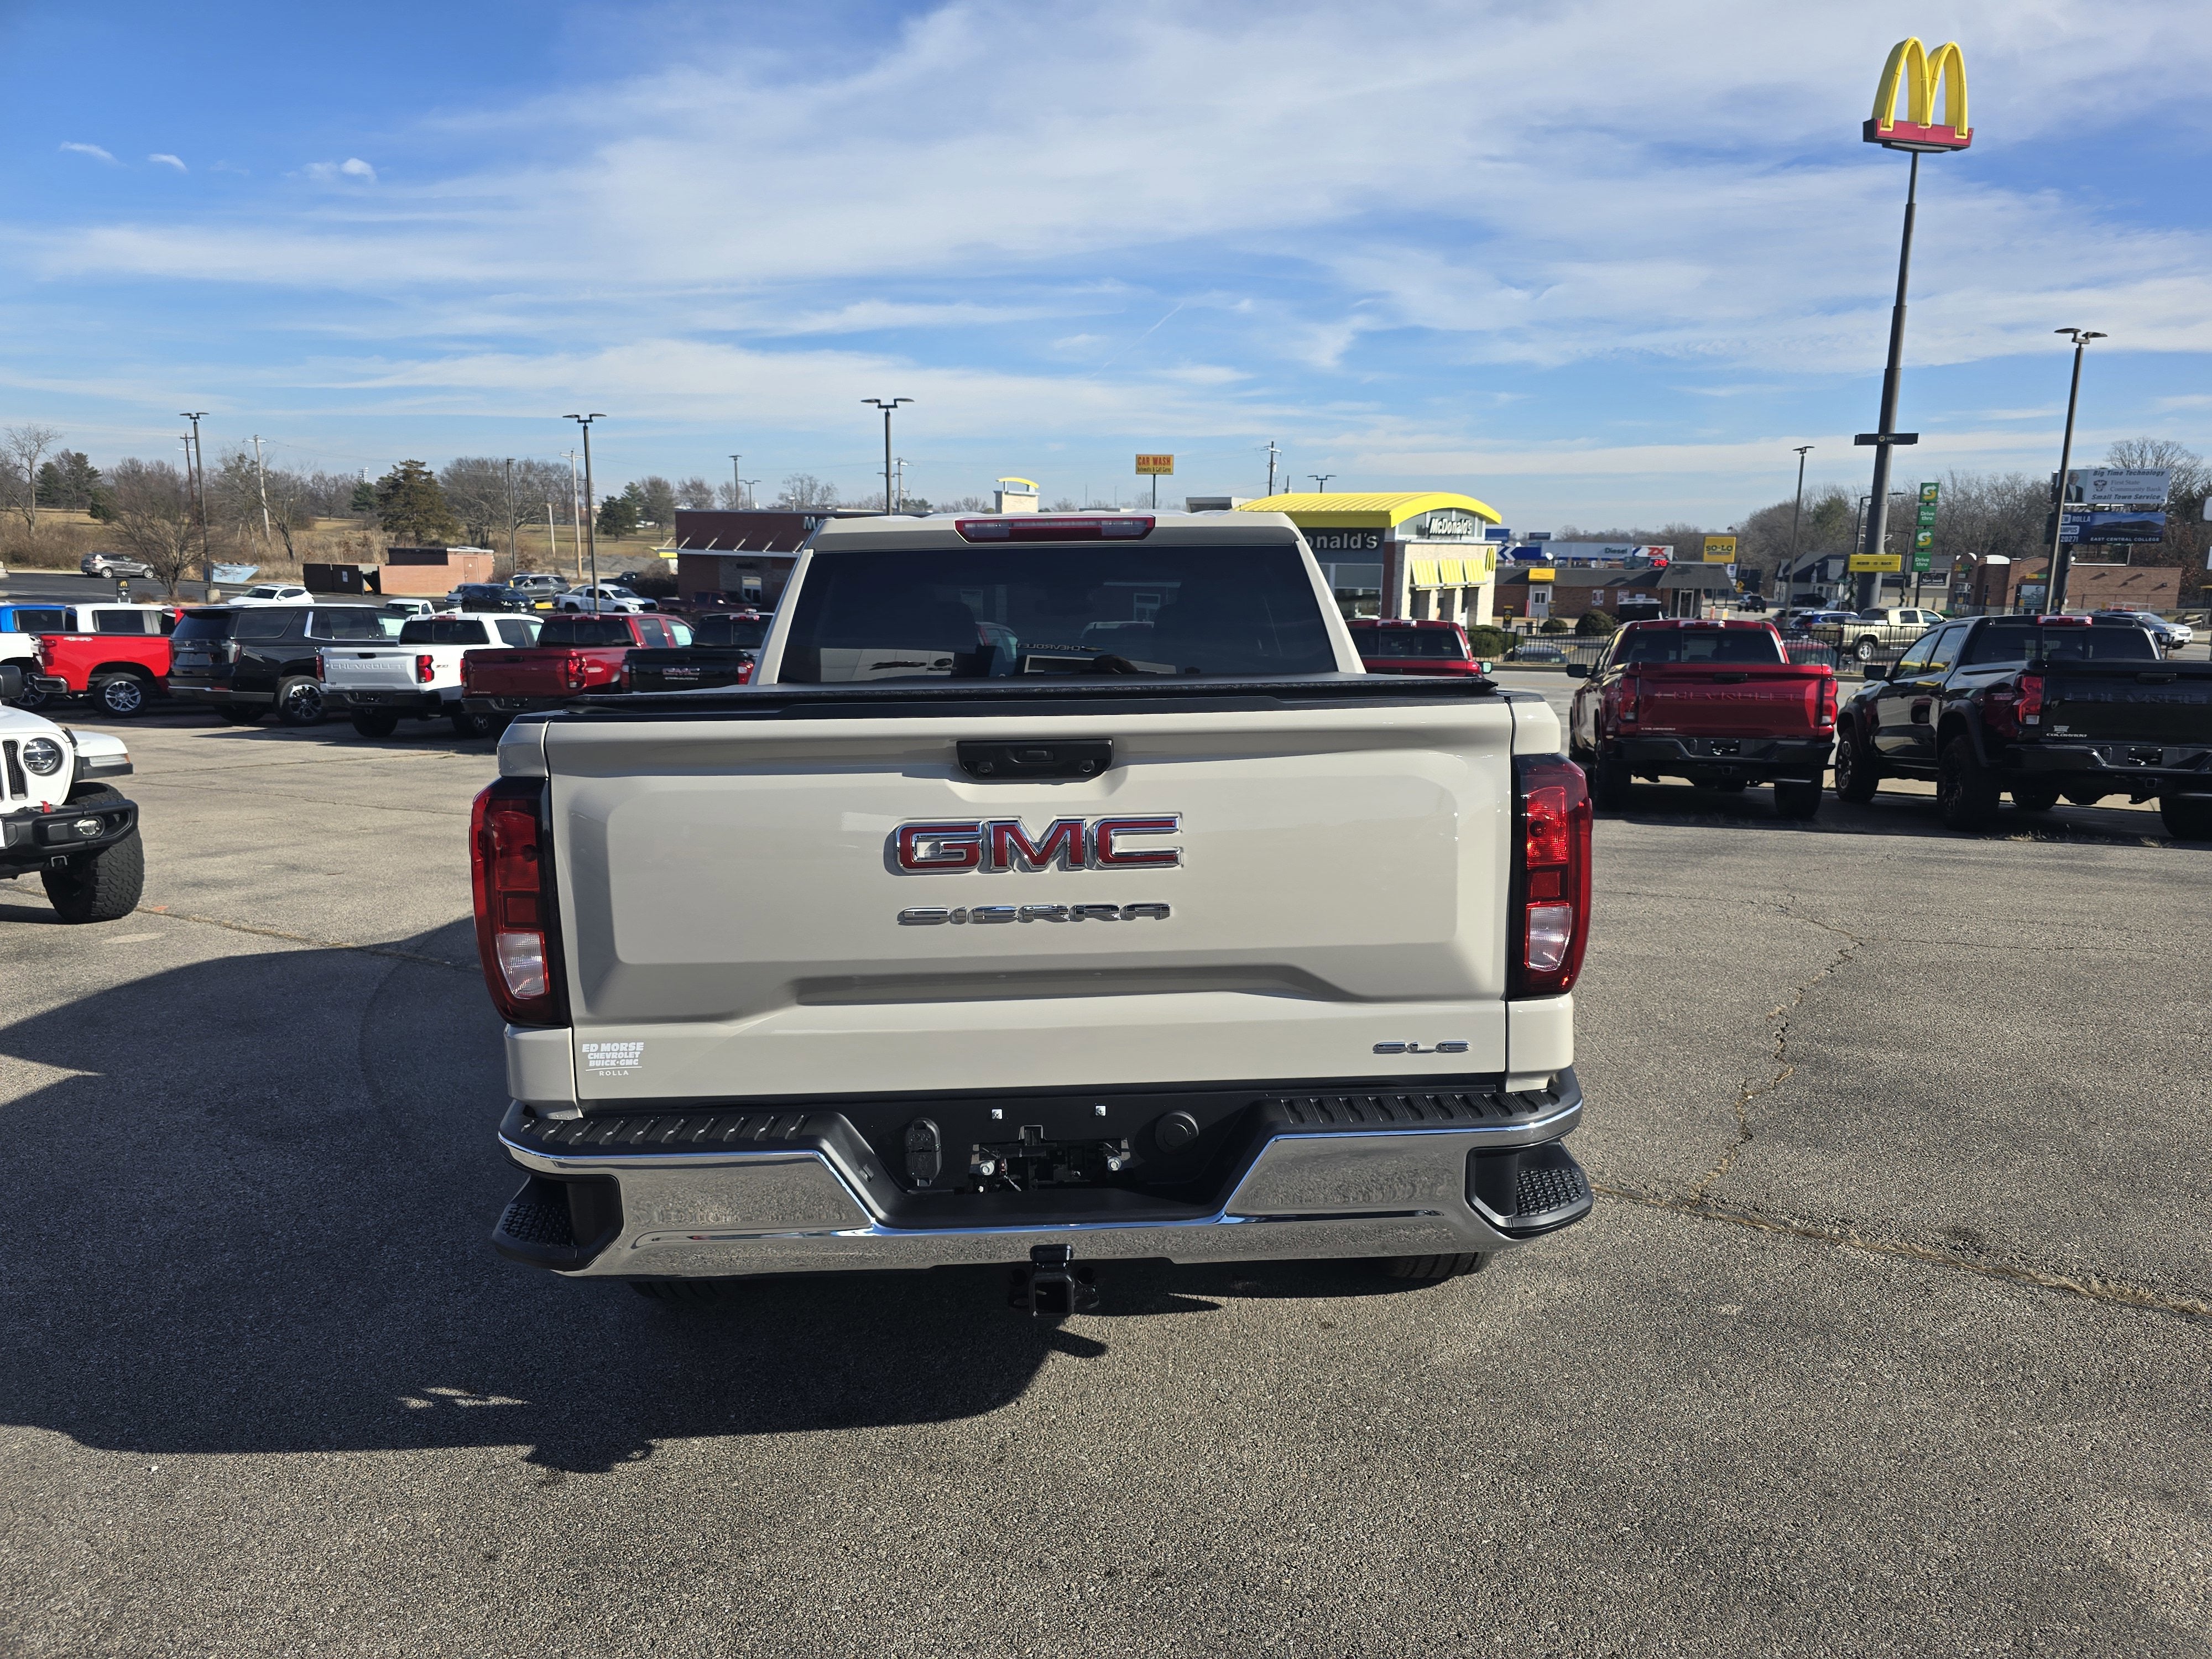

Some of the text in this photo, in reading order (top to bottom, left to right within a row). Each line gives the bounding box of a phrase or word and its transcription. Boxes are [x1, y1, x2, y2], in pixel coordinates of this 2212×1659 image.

[1138, 457, 1170, 466] CAR WASH
[1430, 518, 1472, 534] McDonald's
[1305, 533, 1378, 549] onald's
[896, 817, 1182, 873] GMC
[899, 904, 1171, 924] SIERRA
[582, 1042, 644, 1052] ED MORSE
[1374, 1041, 1469, 1053] SLE
[588, 1051, 640, 1060] CHEVROLET
